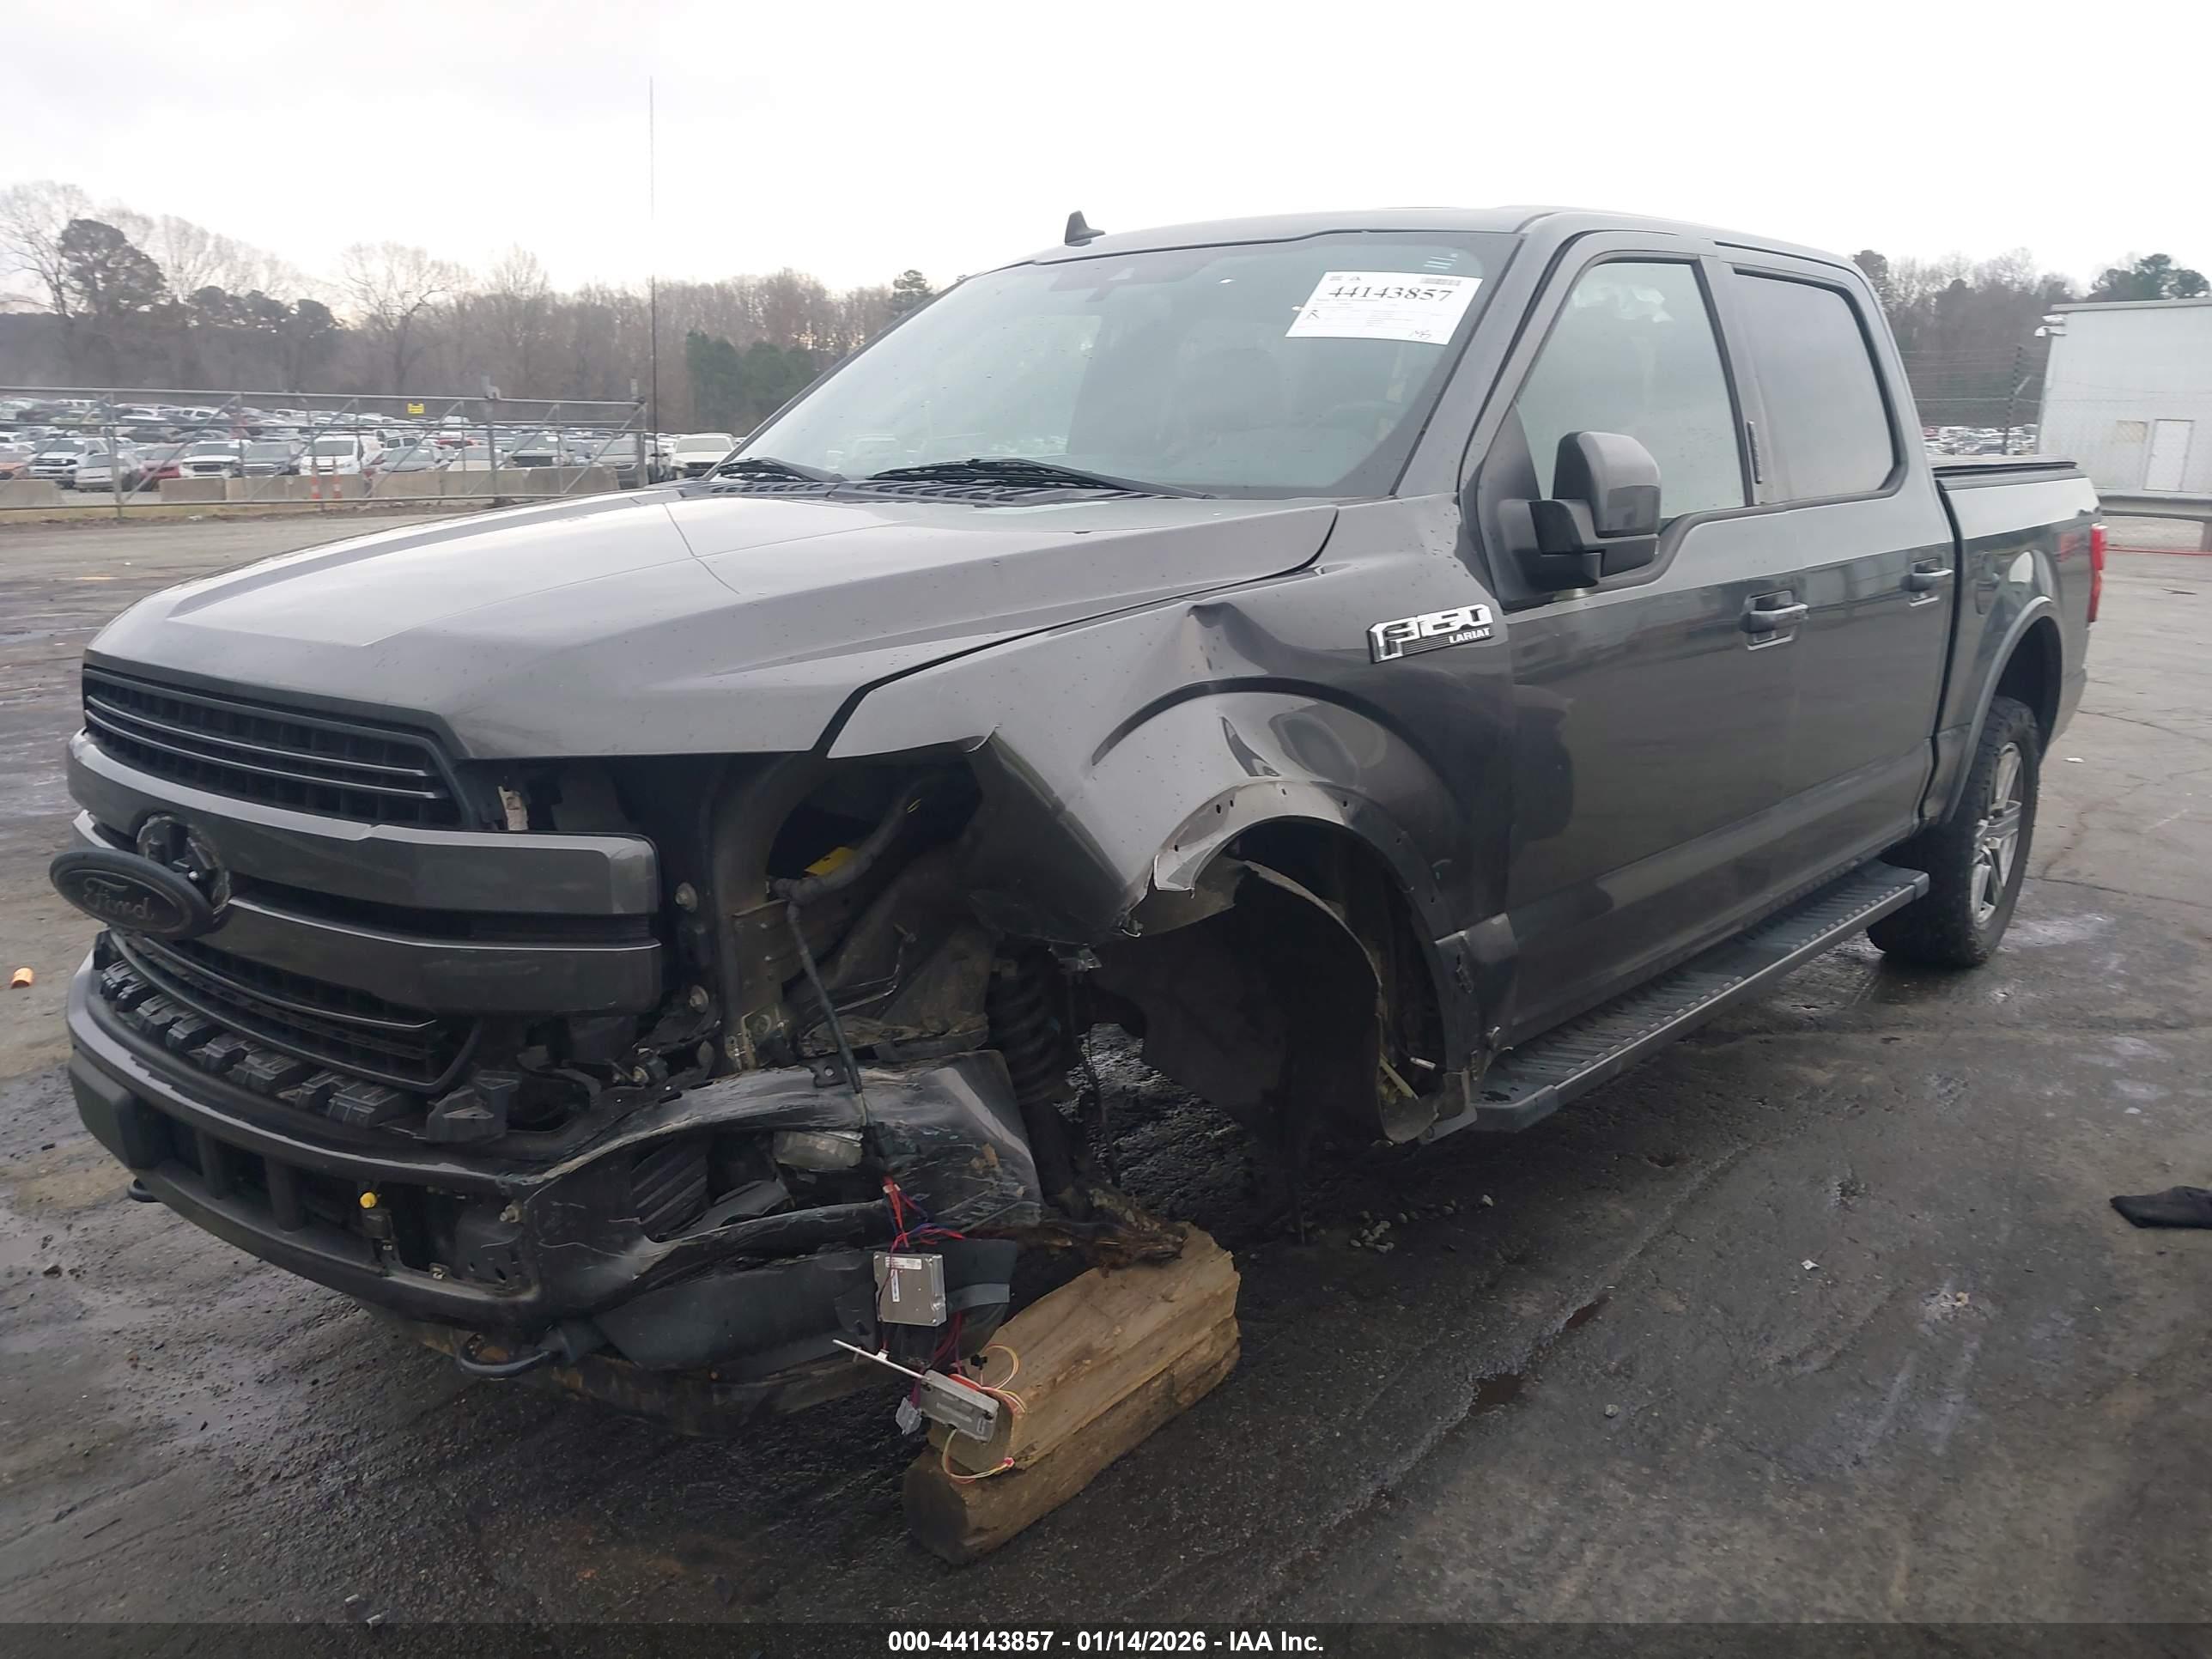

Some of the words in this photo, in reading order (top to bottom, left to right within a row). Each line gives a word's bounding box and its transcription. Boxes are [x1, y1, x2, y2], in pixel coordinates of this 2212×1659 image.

[1328, 286, 1453, 301] 44143857
[1449, 629, 1491, 643] LARIAT
[82, 877, 154, 921] Ford
